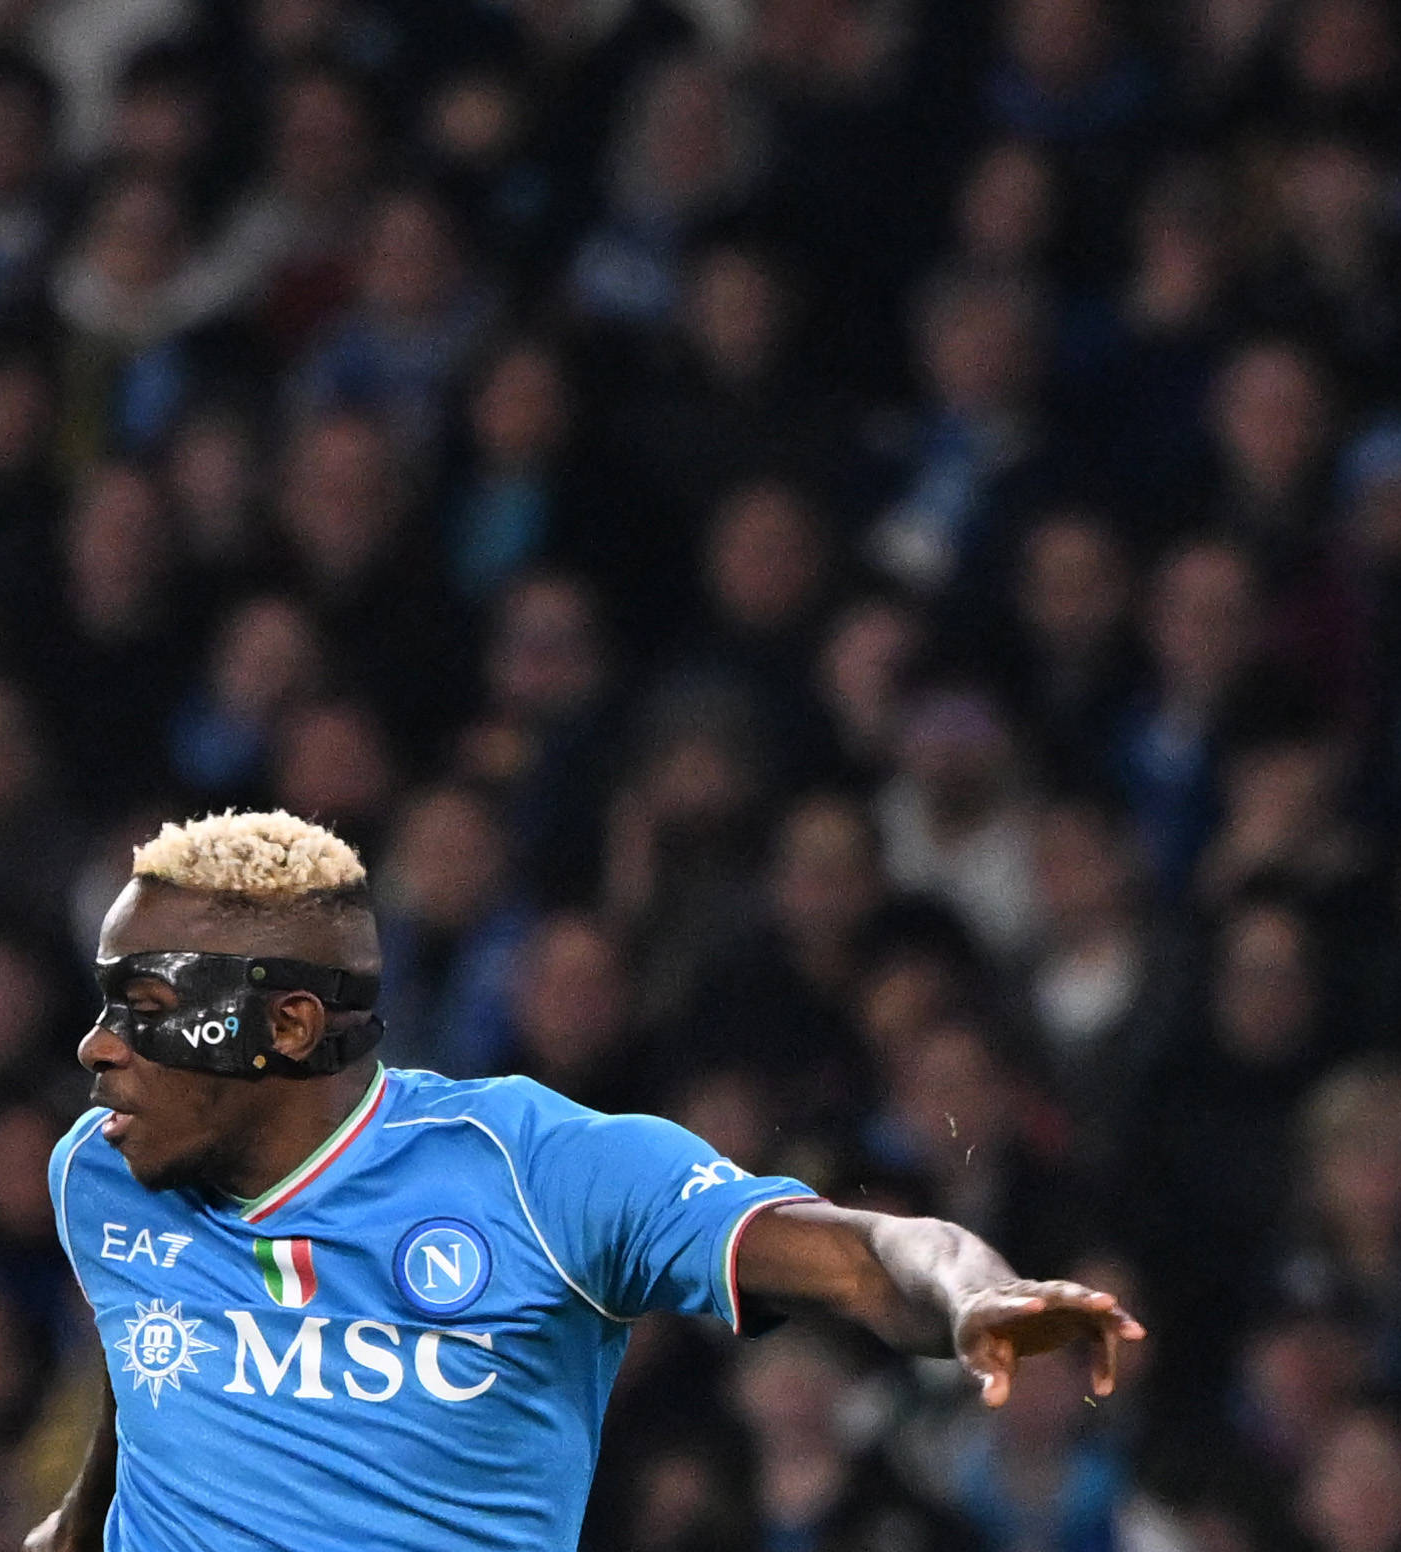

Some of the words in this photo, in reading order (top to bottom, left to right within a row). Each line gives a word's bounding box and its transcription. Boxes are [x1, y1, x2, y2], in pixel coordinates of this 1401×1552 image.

[100, 1222, 194, 1268] EA7
[420, 1243, 462, 1289] N
[222, 1309, 498, 1403] MSC
